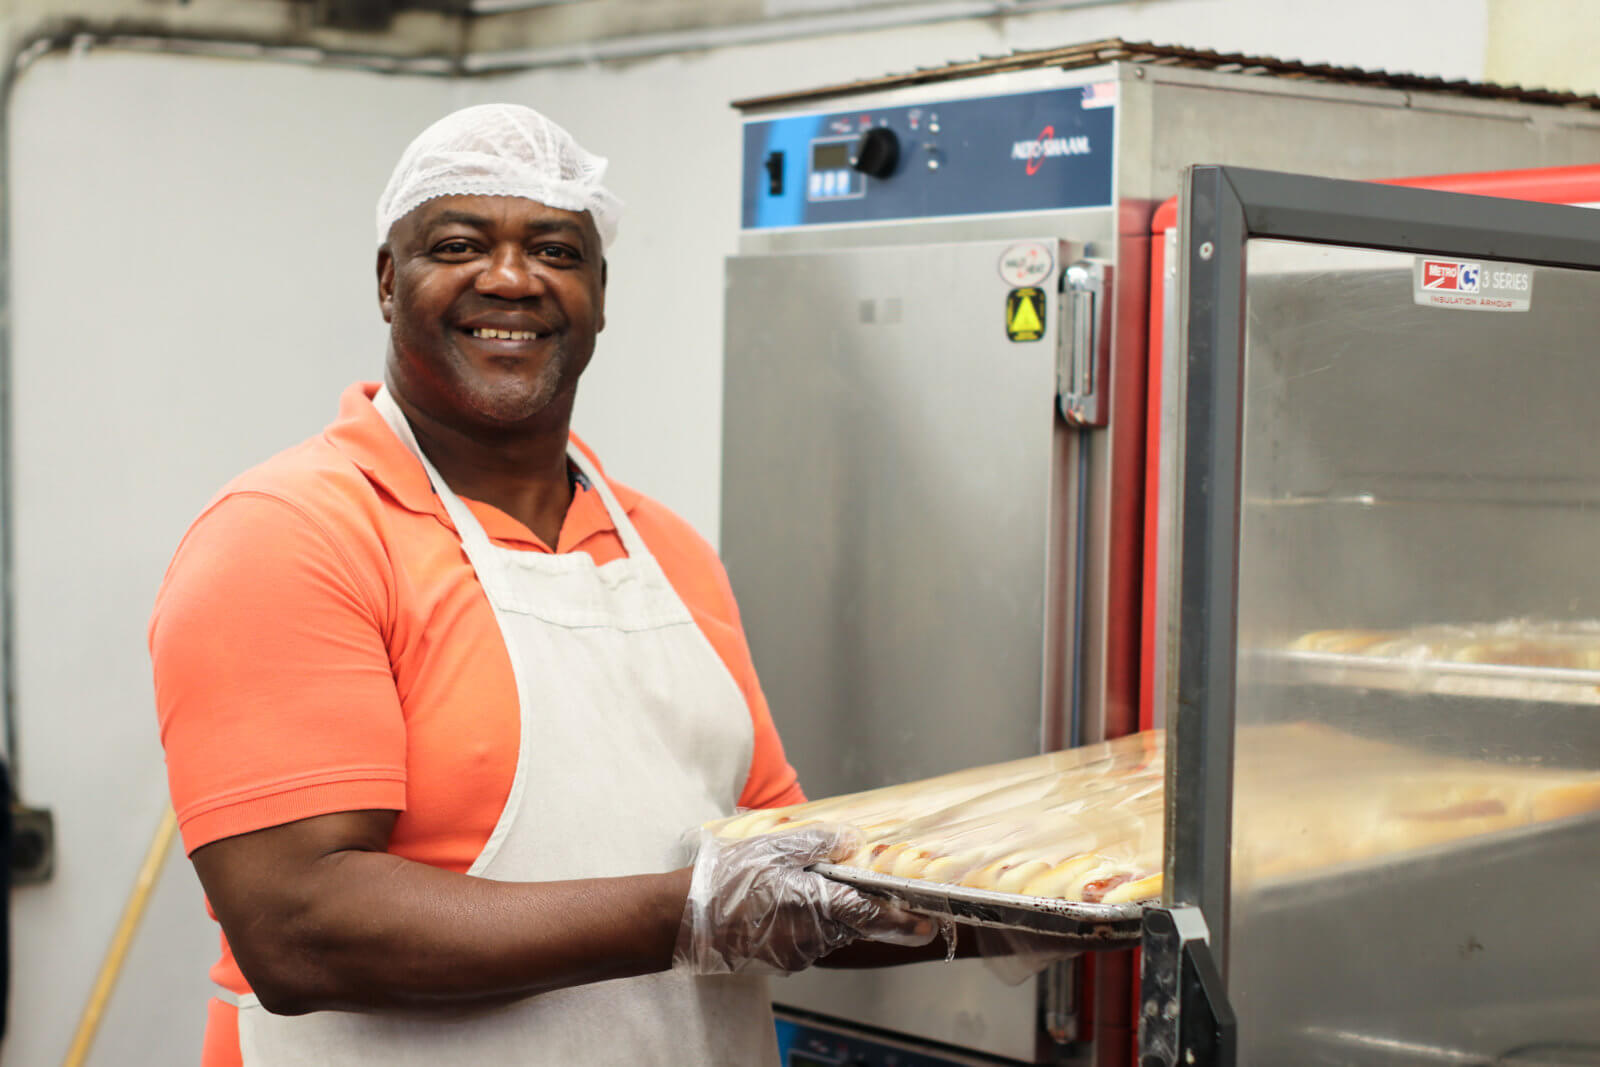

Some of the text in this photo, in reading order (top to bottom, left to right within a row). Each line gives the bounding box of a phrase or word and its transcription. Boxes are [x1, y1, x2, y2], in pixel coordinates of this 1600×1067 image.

[1482, 270, 1489, 289] 3
[1492, 272, 1528, 291] SERIES
[1430, 295, 1477, 305] INSULATION
